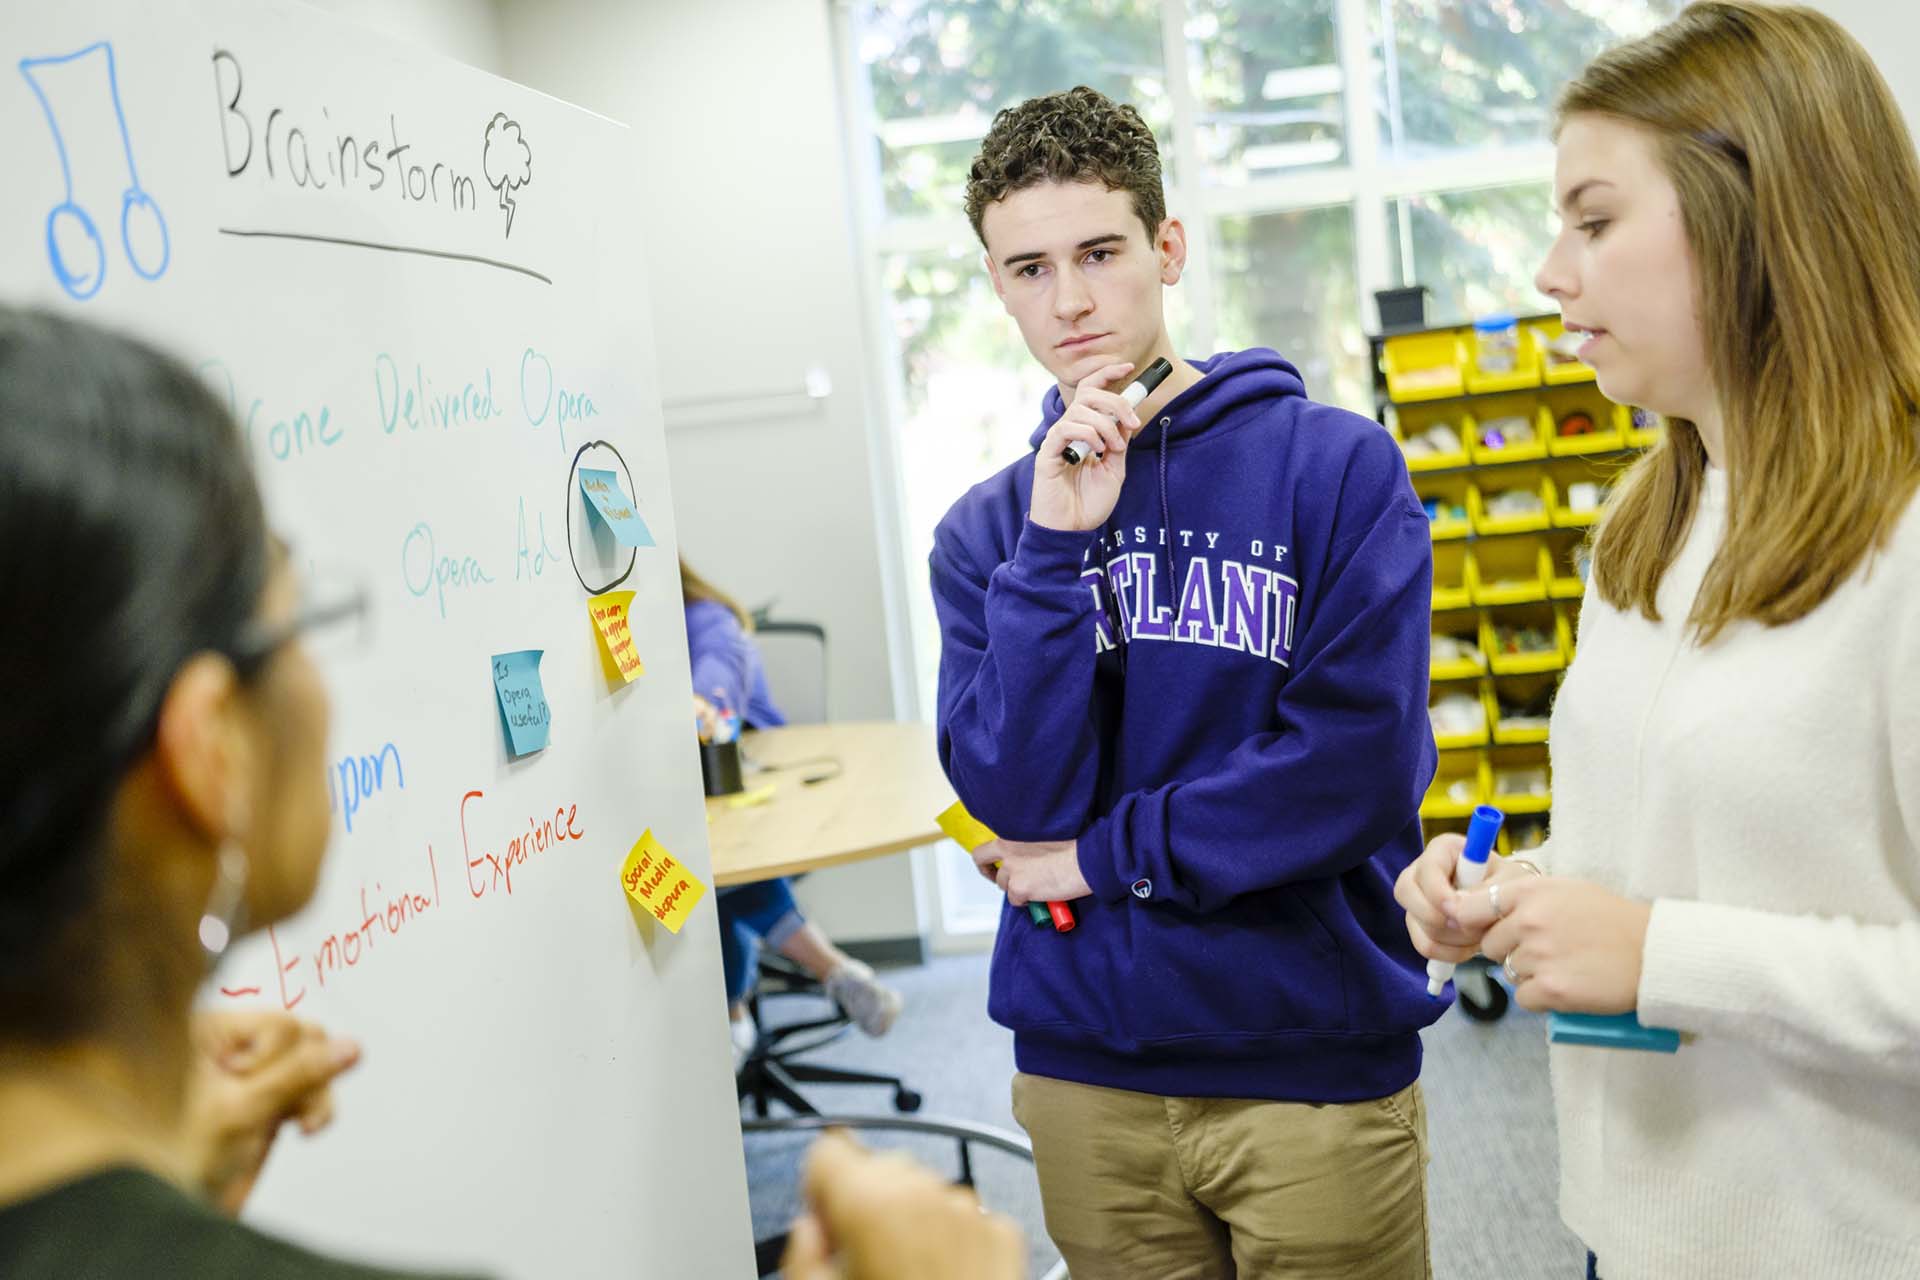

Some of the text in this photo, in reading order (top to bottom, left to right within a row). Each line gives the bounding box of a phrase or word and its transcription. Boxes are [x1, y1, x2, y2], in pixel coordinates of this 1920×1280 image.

[210, 47, 477, 212] Brainstorm
[375, 352, 502, 434] Delivered
[520, 347, 600, 454] Opera
[402, 495, 561, 619] Opera Ad
[1100, 526, 1288, 562] RSITY OF
[494, 660, 510, 681] Is
[503, 687, 533, 707] Opera
[624, 849, 654, 892] Social
[639, 856, 676, 899] Media
[268, 843, 439, 1012] Emotional
[460, 790, 584, 899] Experience
